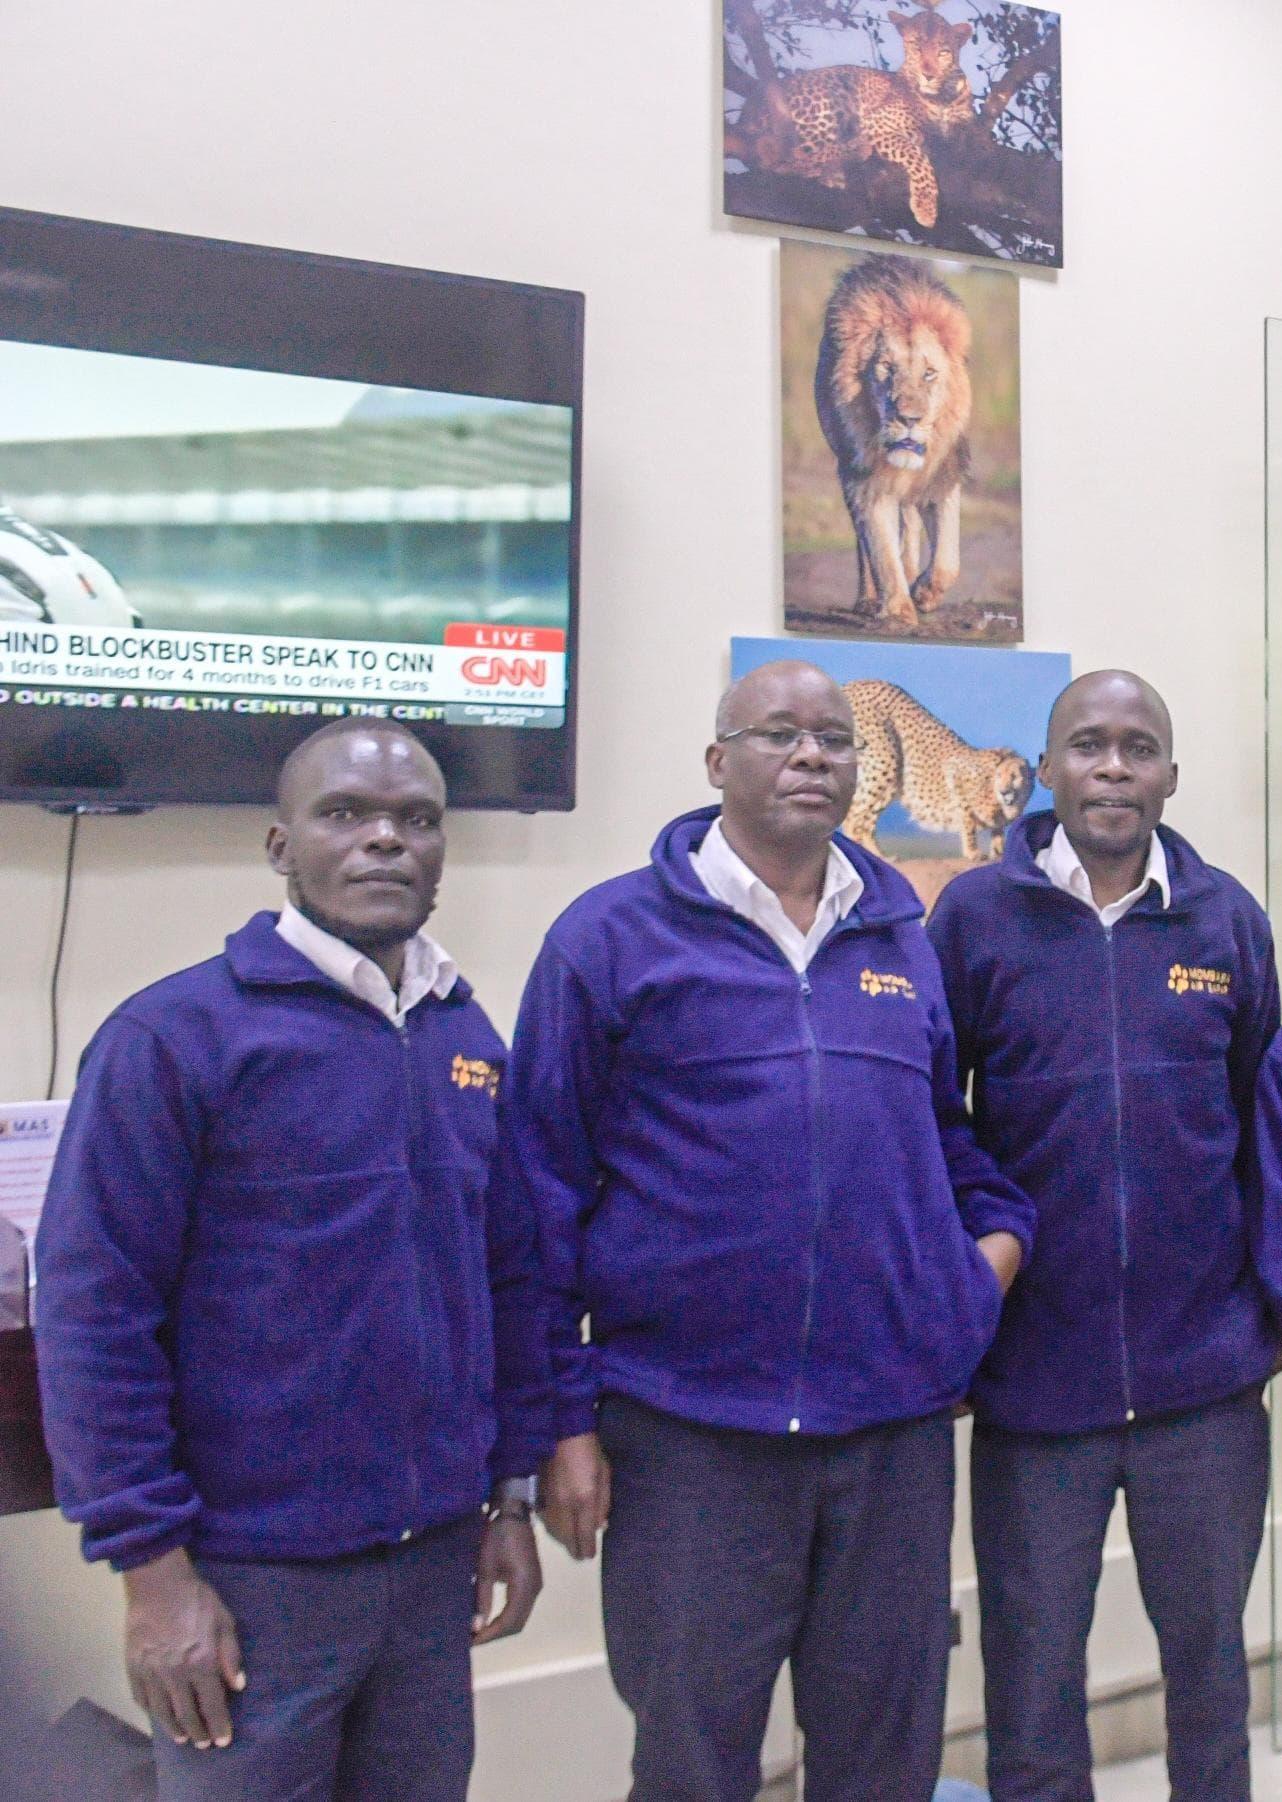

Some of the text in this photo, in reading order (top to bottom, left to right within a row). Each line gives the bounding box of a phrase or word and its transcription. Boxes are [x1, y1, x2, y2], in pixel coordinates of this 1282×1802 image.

[70, 635, 252, 664] BLOCKBUSTER
[263, 645, 338, 668] SPEAK
[348, 650, 377, 671] TO
[386, 652, 433, 673] CNN
[475, 629, 536, 647] LIVE
[12, 660, 57, 677] Idris
[66, 662, 139, 679] trained
[149, 666, 174, 681] for
[183, 668, 194, 681] 4
[203, 670, 276, 687] months
[285, 673, 302, 687] to
[309, 675, 355, 689] drive
[362, 676, 382, 689] F1
[389, 680, 429, 693] cars
[461, 655, 546, 687] CNN
[14, 689, 116, 708] OUTSIDE
[121, 694, 138, 708] A
[143, 695, 228, 712] HEALTH
[233, 698, 318, 715] CENTER
[350, 703, 388, 719] THE
